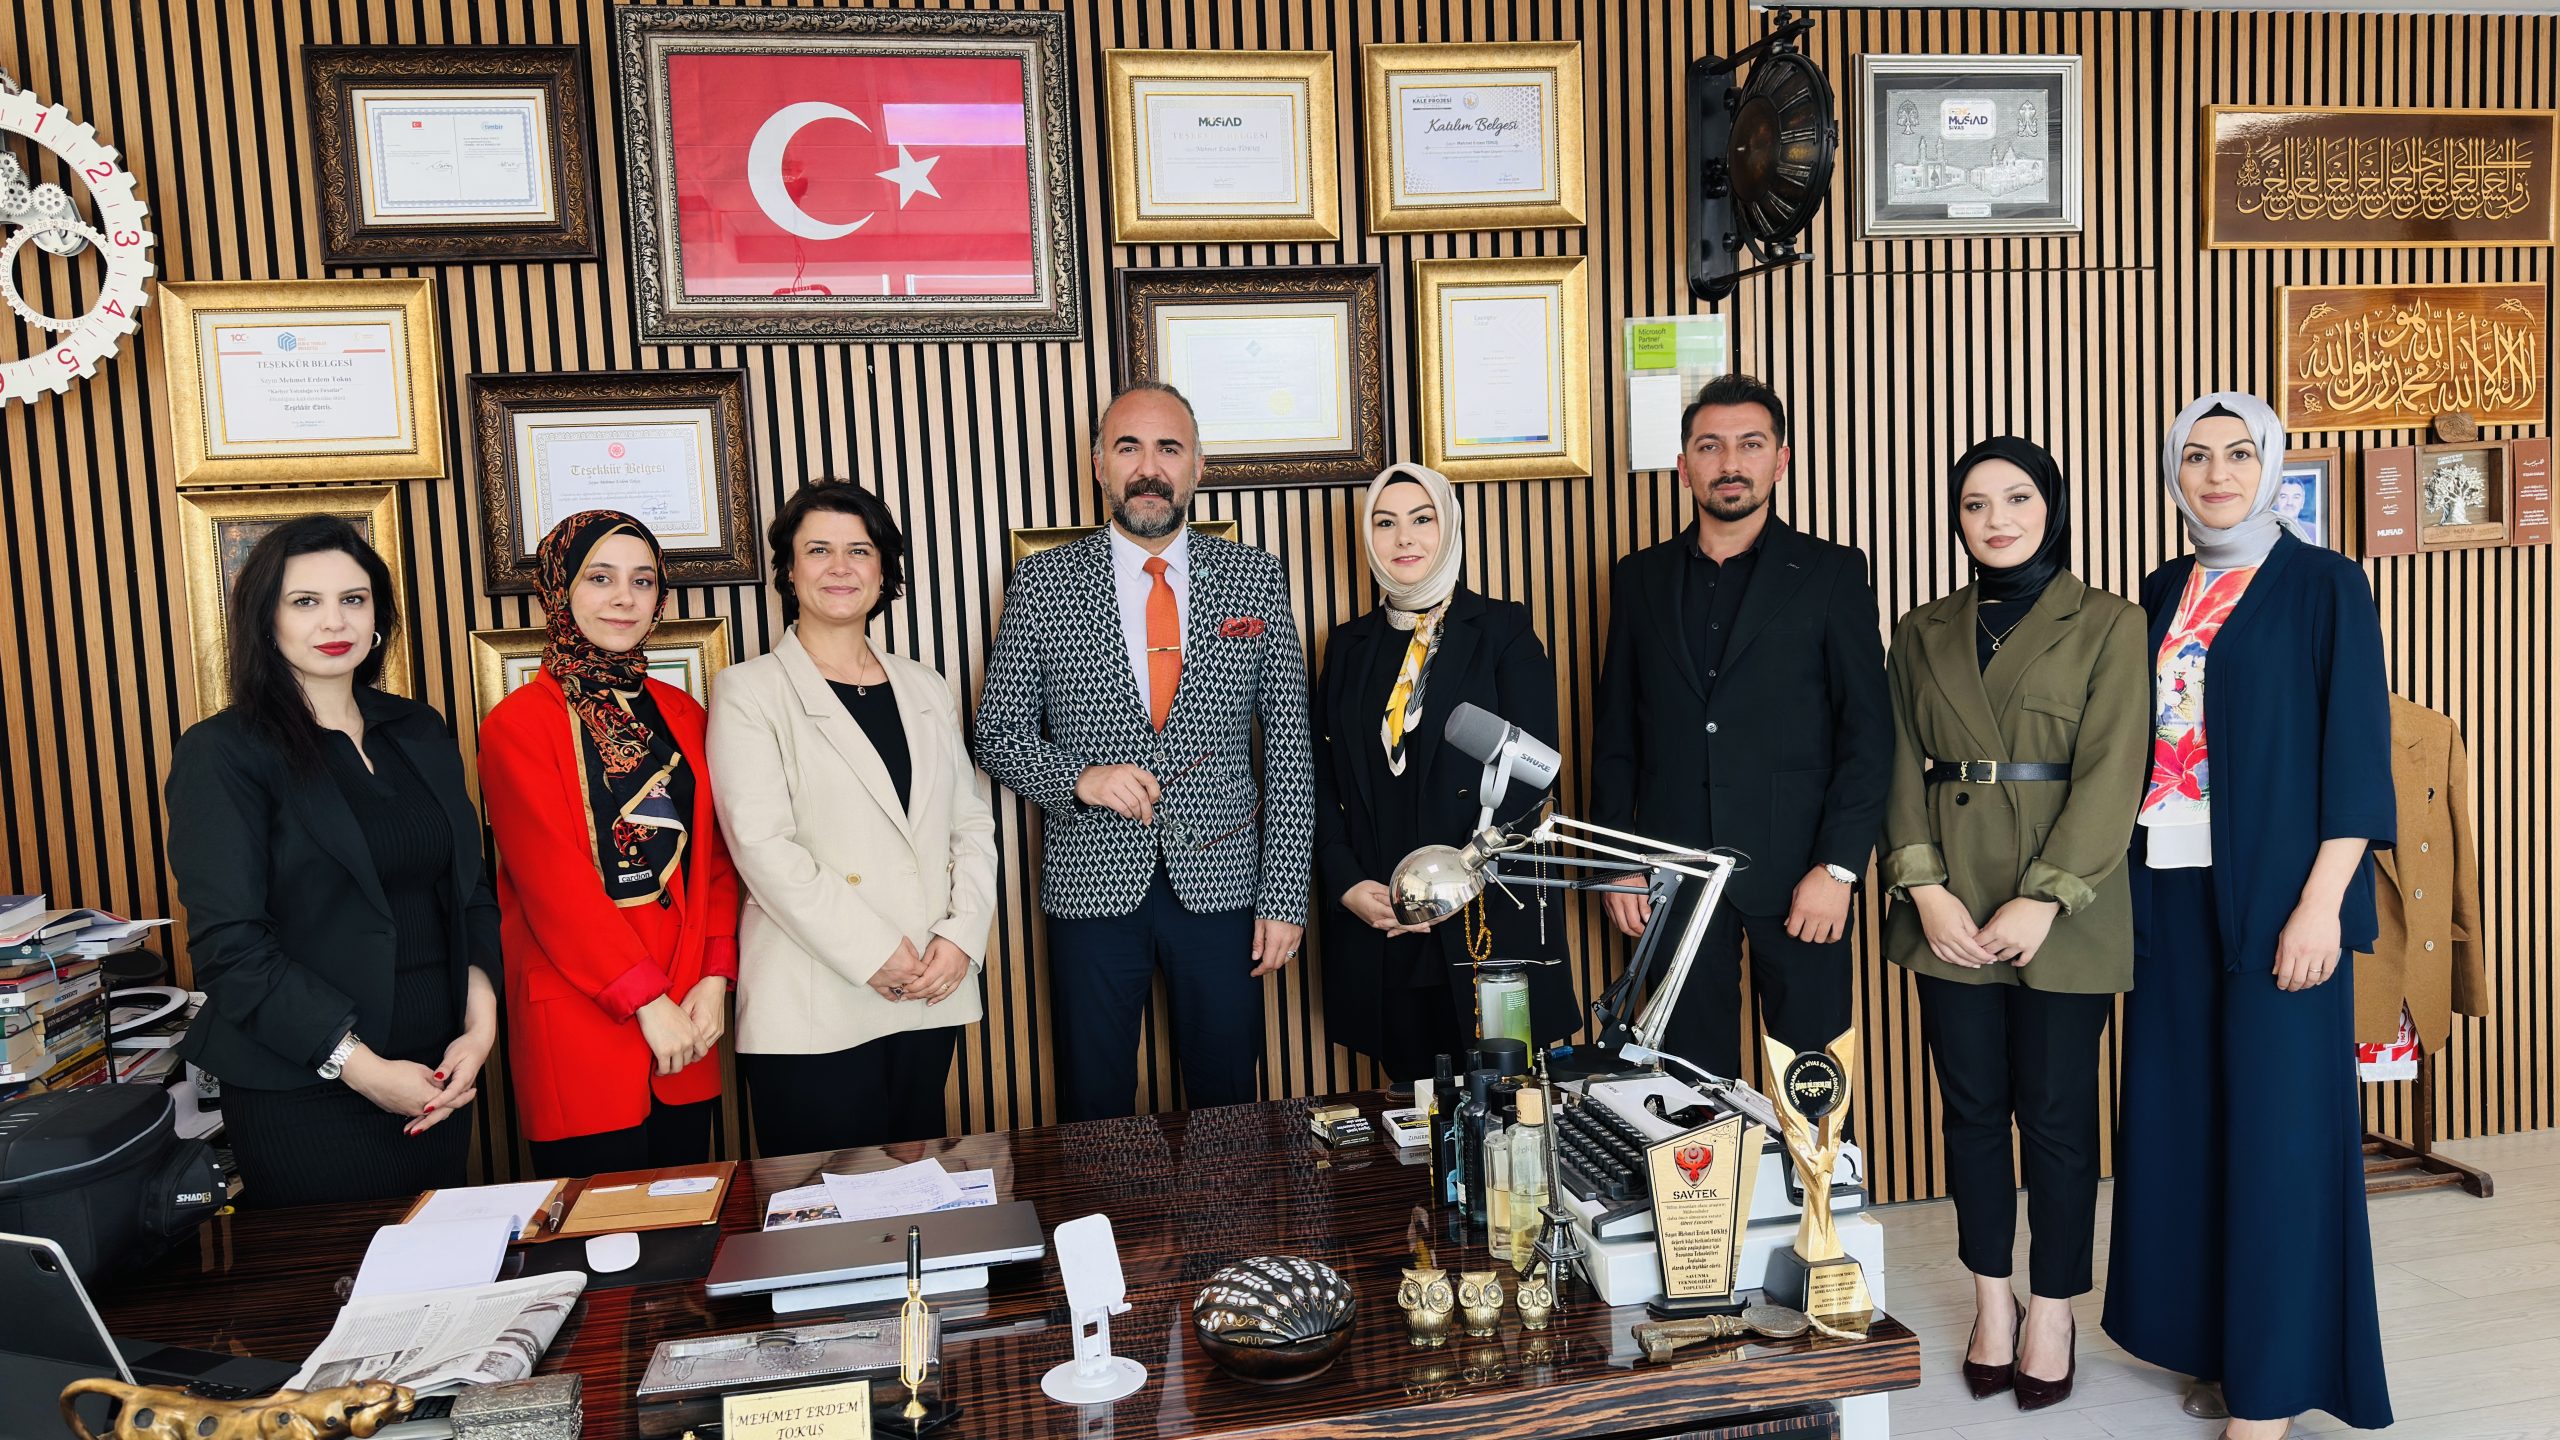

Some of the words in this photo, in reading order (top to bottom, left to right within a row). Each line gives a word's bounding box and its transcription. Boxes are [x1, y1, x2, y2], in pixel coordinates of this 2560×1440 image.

[34, 112, 47, 133] 1
[1424, 118, 1473, 134] Katılım
[1474, 117, 1519, 136] Belgesi
[86, 161, 113, 184] 2
[114, 230, 140, 247] 3
[102, 299, 125, 318] 4
[57, 348, 80, 372] 5
[312, 358, 353, 368] BELGESİ
[570, 463, 620, 478] Teşekkür
[624, 462, 666, 475] Belgesi
[1520, 753, 1551, 773] SHURE
[176, 1193, 203, 1203] SHAD
[1673, 1189, 1717, 1200] SAVTEK
[735, 1408, 803, 1427] MEHMET
[806, 1401, 859, 1418] ERDEM
